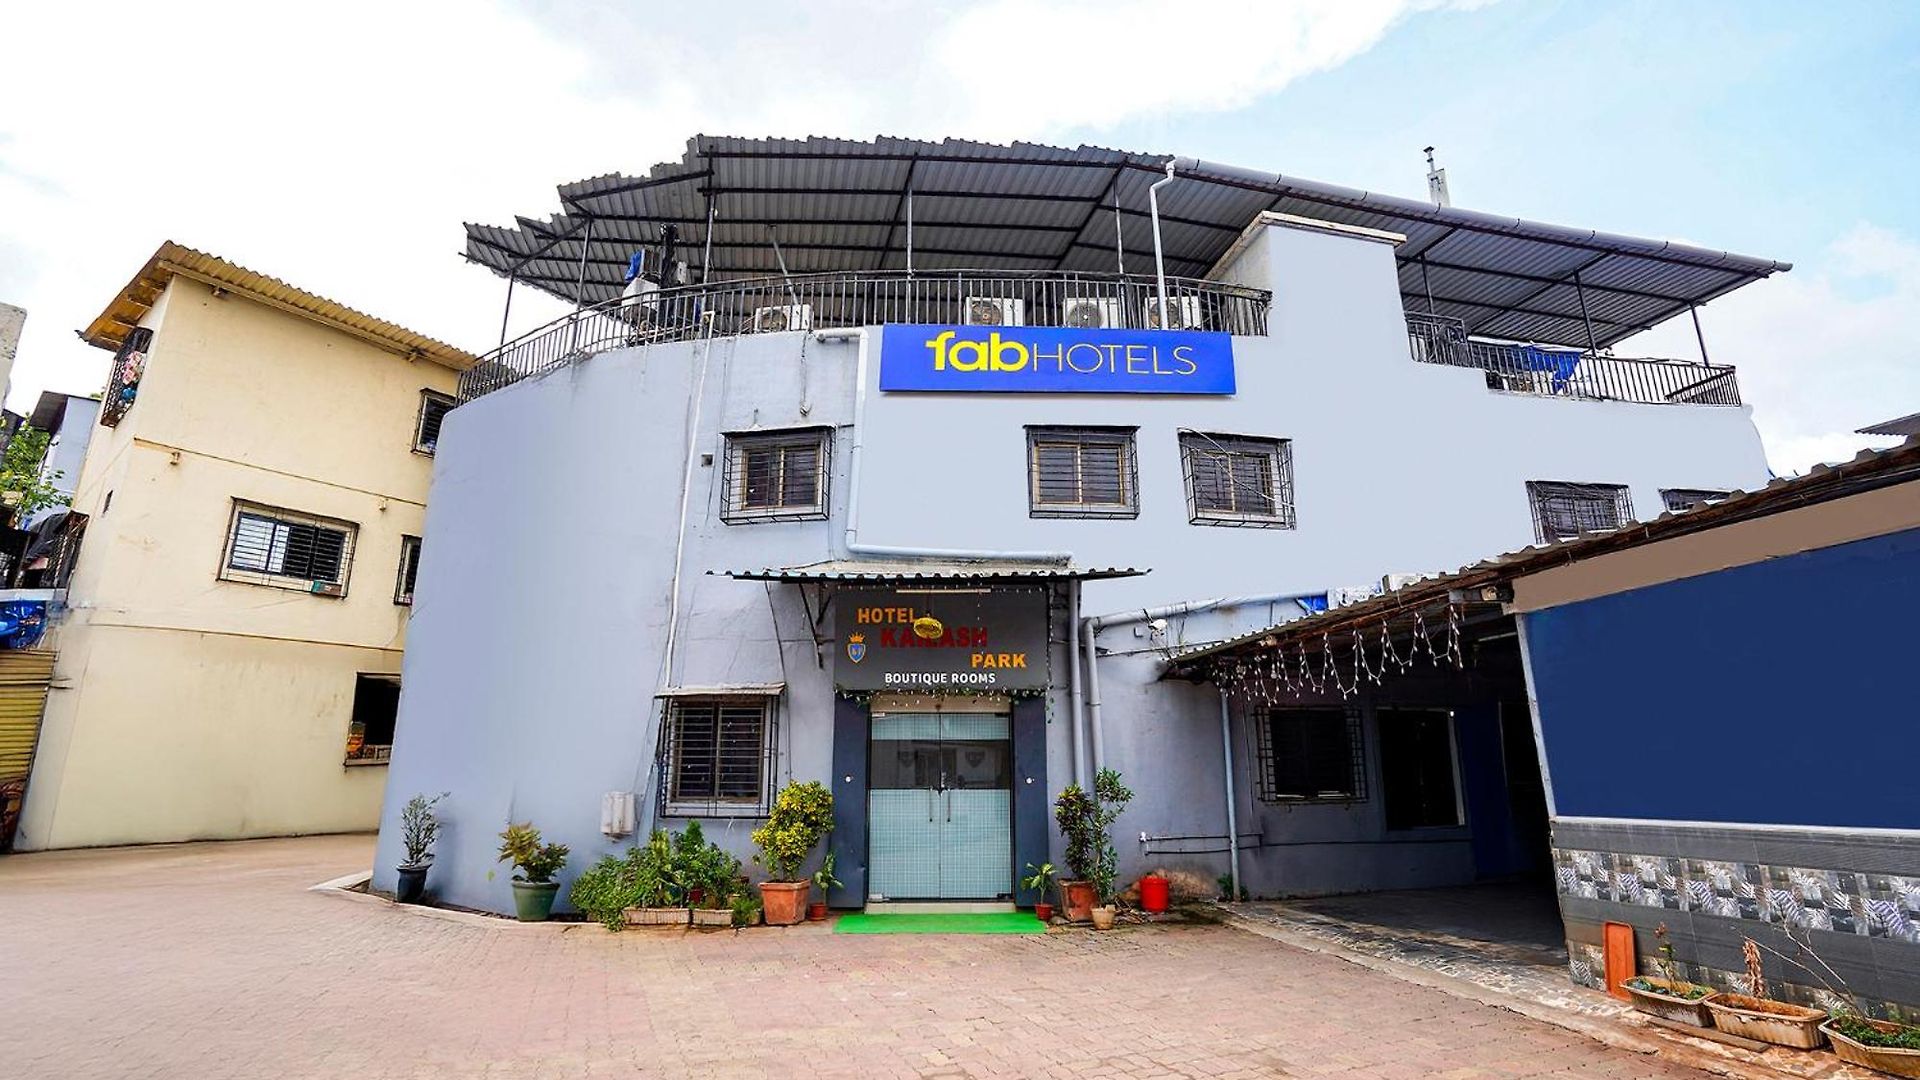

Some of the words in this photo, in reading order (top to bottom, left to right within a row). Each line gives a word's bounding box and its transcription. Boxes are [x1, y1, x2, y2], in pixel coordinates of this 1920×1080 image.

[925, 331, 1198, 375] fabHOTELS
[857, 607, 916, 624] HOTEL
[971, 653, 1026, 669] PARK
[884, 673, 947, 685] BOUTIQUE
[951, 673, 996, 684] ROOMS
